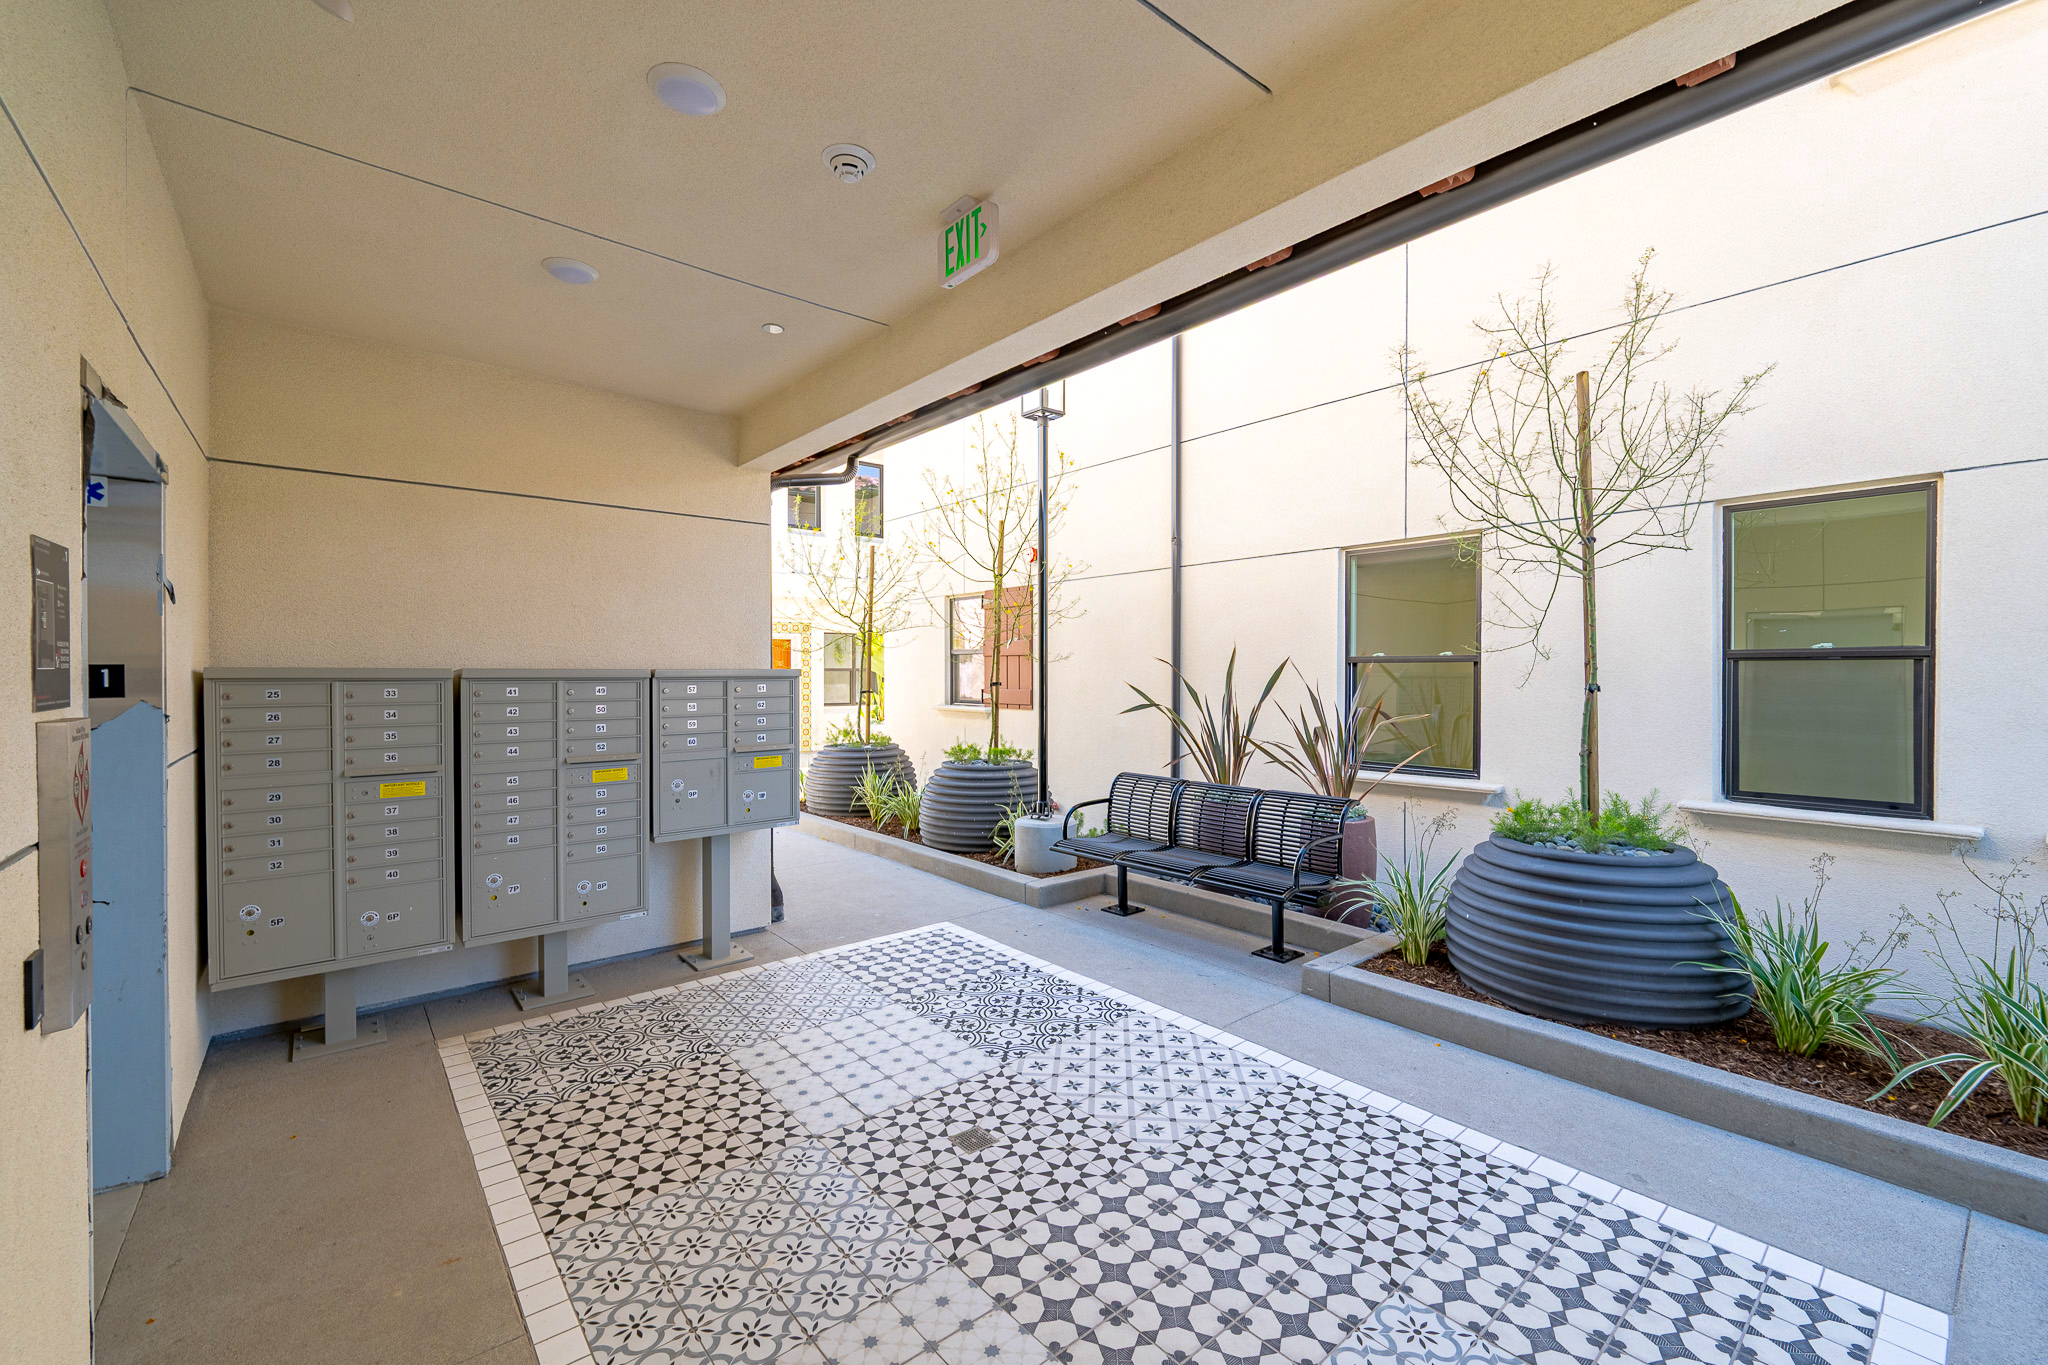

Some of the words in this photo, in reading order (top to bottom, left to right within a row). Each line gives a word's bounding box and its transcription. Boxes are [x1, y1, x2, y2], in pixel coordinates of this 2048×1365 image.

[945, 206, 982, 278] EXIT
[100, 668, 109, 688] 1
[269, 794, 281, 802] 29
[387, 849, 398, 857] 39
[270, 861, 282, 870] 32
[270, 918, 284, 926] 5P
